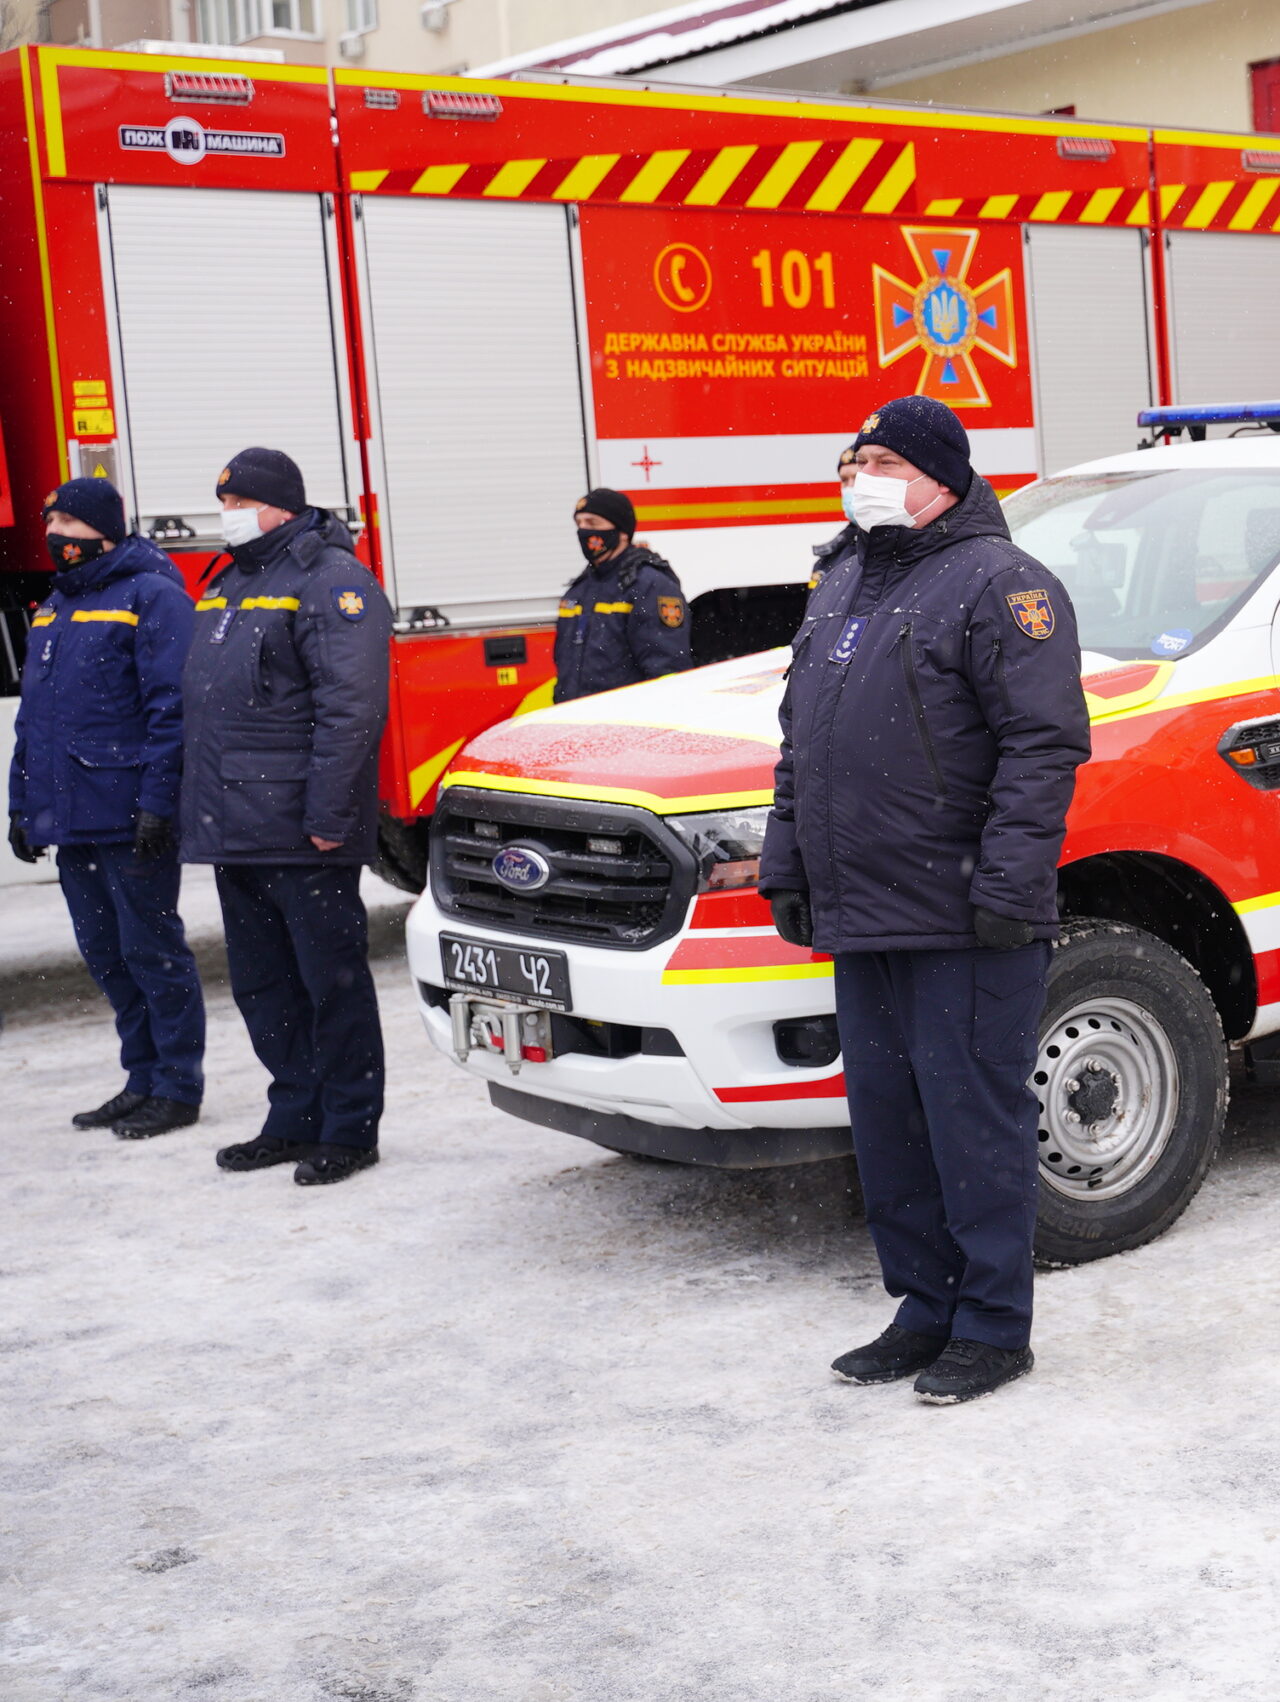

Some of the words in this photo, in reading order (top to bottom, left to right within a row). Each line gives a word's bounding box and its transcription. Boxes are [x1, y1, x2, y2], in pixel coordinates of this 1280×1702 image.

[124, 130, 165, 147] ПОЖ
[207, 136, 280, 153] МАШИНА
[752, 250, 836, 309] 101
[604, 333, 708, 355] ДЕРЖАВНА
[712, 333, 786, 353] СЛУЖБА
[791, 331, 867, 353] УКРАЇНИ
[606, 360, 619, 379] З
[626, 355, 775, 381] НАДЗВИЧАЙНИХ
[781, 356, 869, 380] СИТУАЦІЙ
[1011, 592, 1043, 603] УКРАЇНА
[500, 854, 531, 881] Ford
[451, 942, 499, 986] 2431
